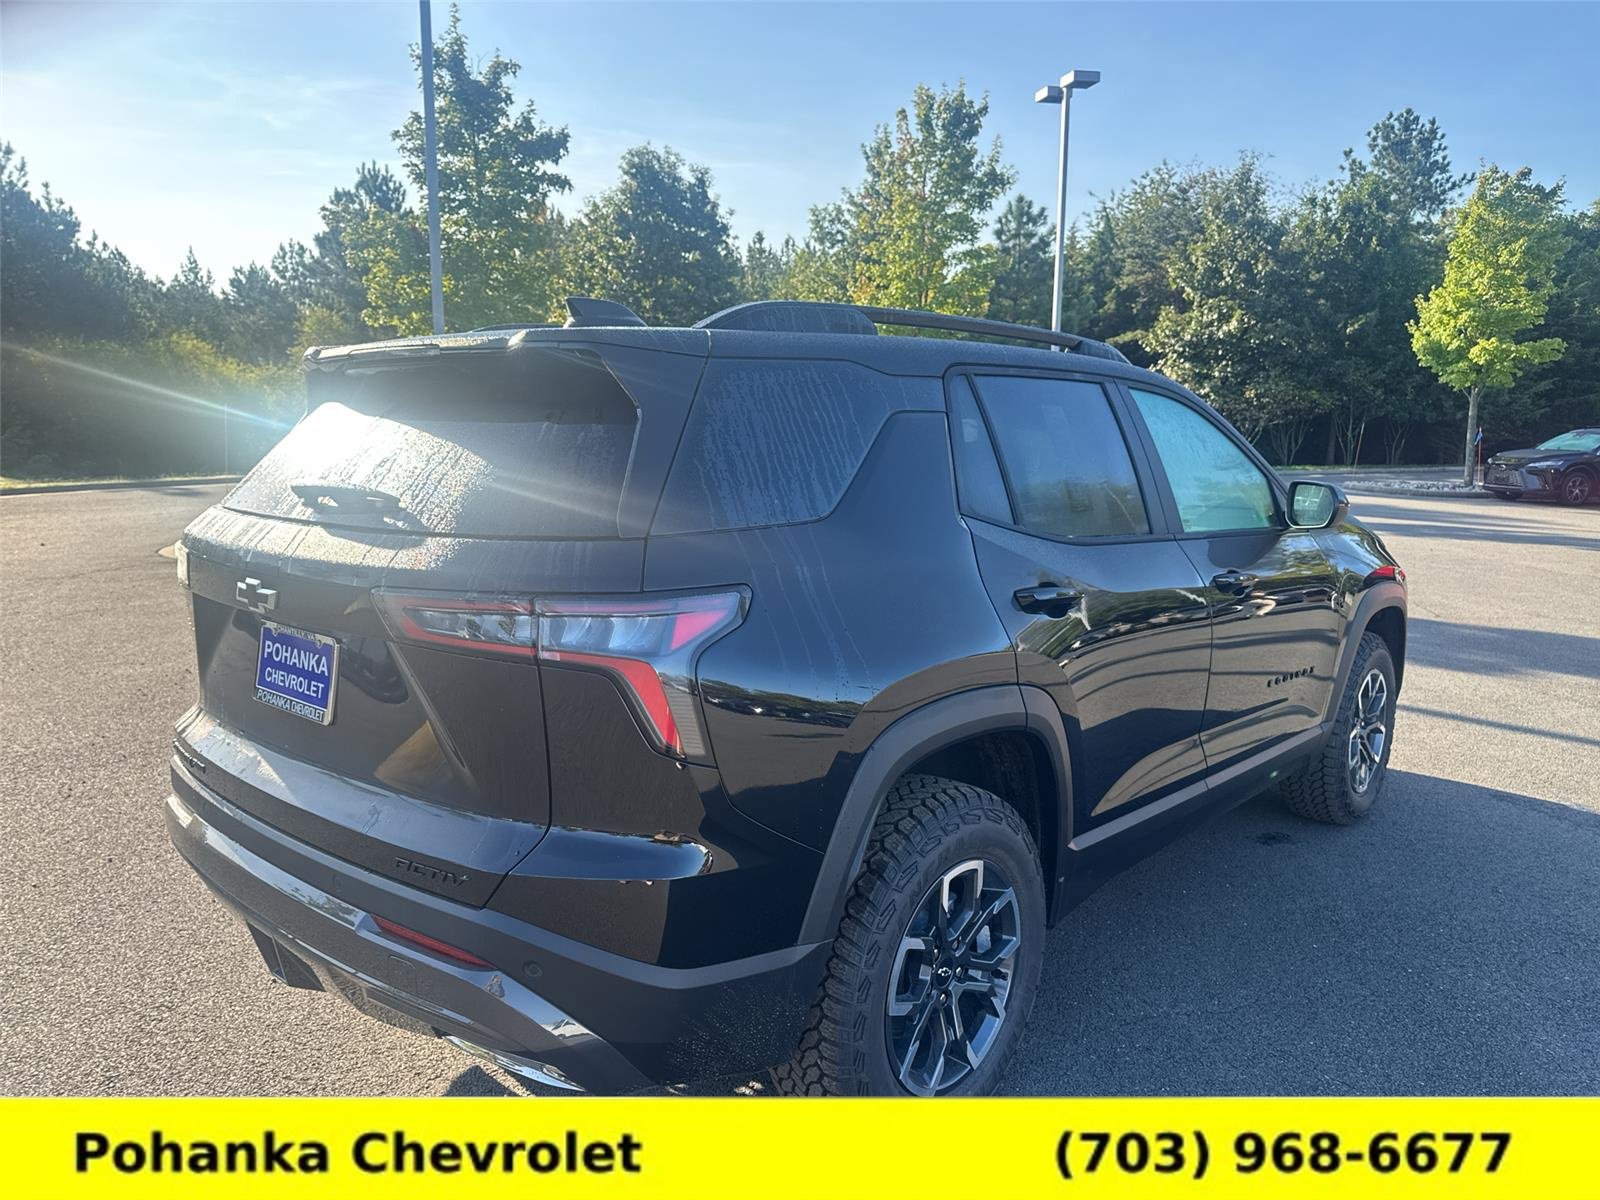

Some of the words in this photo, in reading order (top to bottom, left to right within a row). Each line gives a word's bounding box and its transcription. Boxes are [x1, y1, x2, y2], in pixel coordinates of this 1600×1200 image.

[264, 640, 328, 676] POHANKA
[265, 667, 325, 698] CHEVROLET
[256, 689, 291, 711] POHANKA
[291, 703, 324, 721] CHEVROLET
